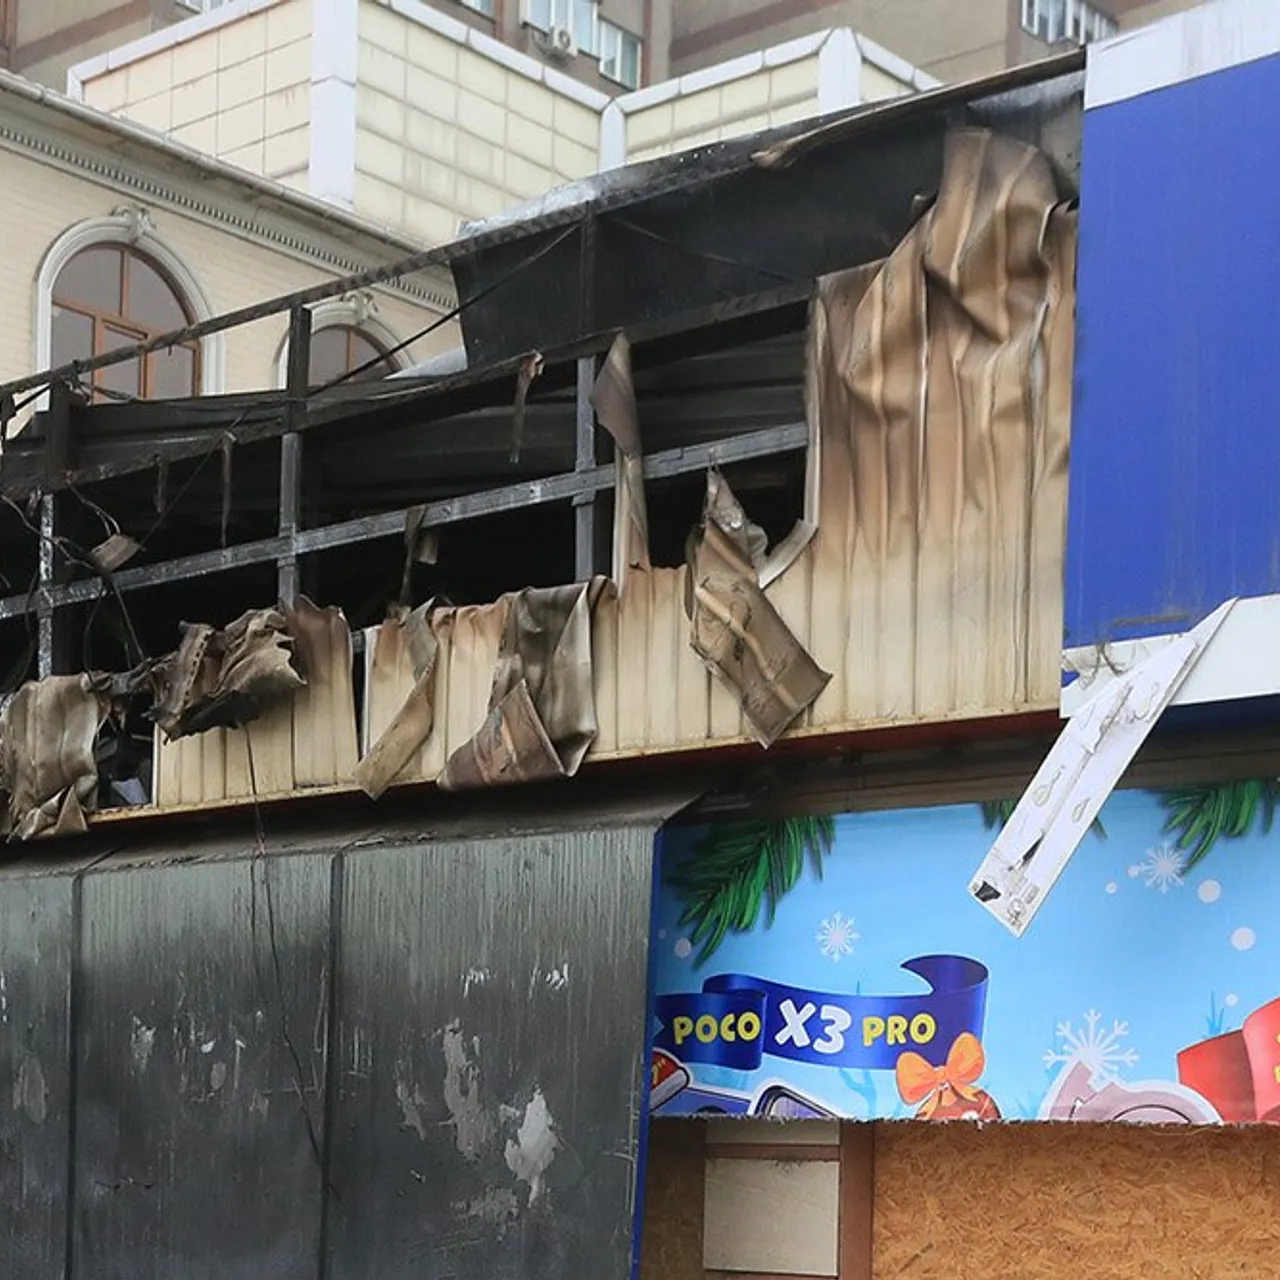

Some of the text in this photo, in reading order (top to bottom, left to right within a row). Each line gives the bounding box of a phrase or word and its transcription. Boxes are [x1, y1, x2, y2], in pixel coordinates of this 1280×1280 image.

[673, 999, 936, 1054] POCO X3 PRO
